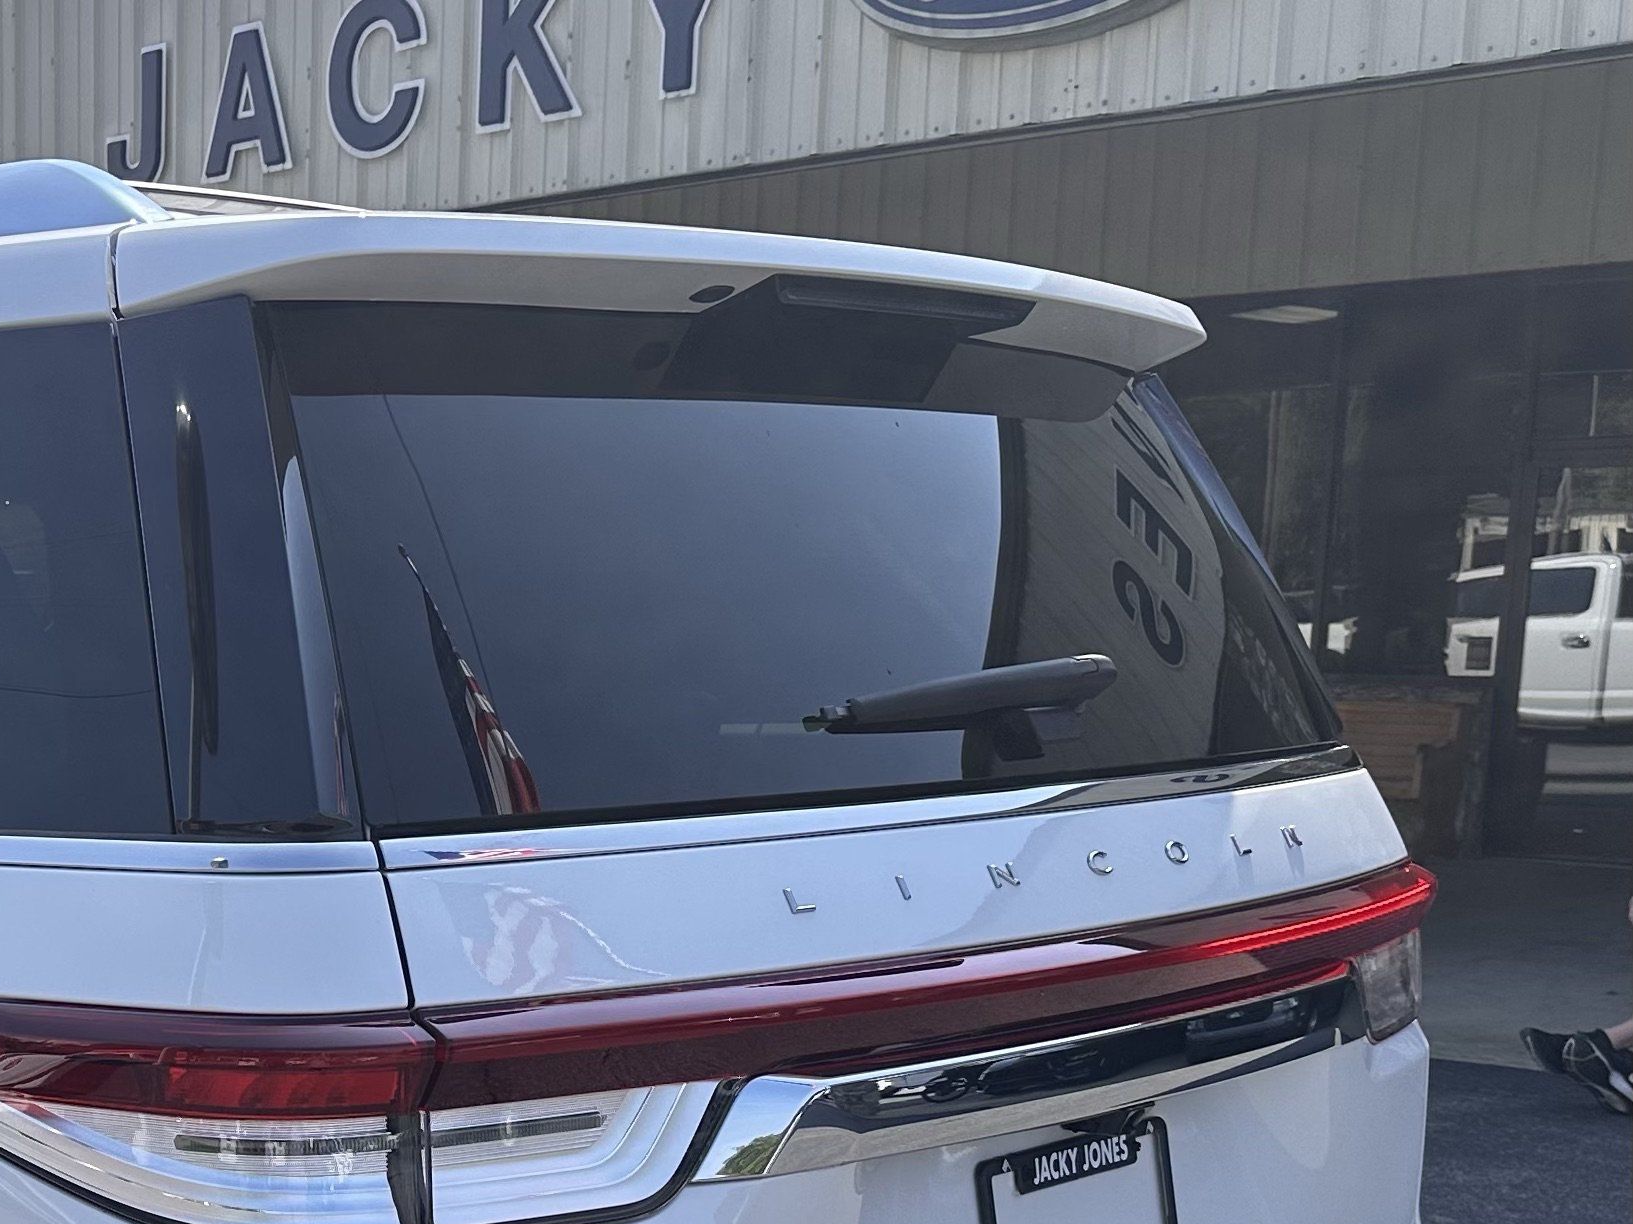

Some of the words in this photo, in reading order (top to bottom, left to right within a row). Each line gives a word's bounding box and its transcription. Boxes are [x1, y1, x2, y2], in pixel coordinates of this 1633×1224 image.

[107, 0, 710, 183] JACKY
[782, 824, 1303, 914] LINCOLN
[1033, 1146, 1078, 1185] JACKY
[1082, 1134, 1129, 1172] JONES
